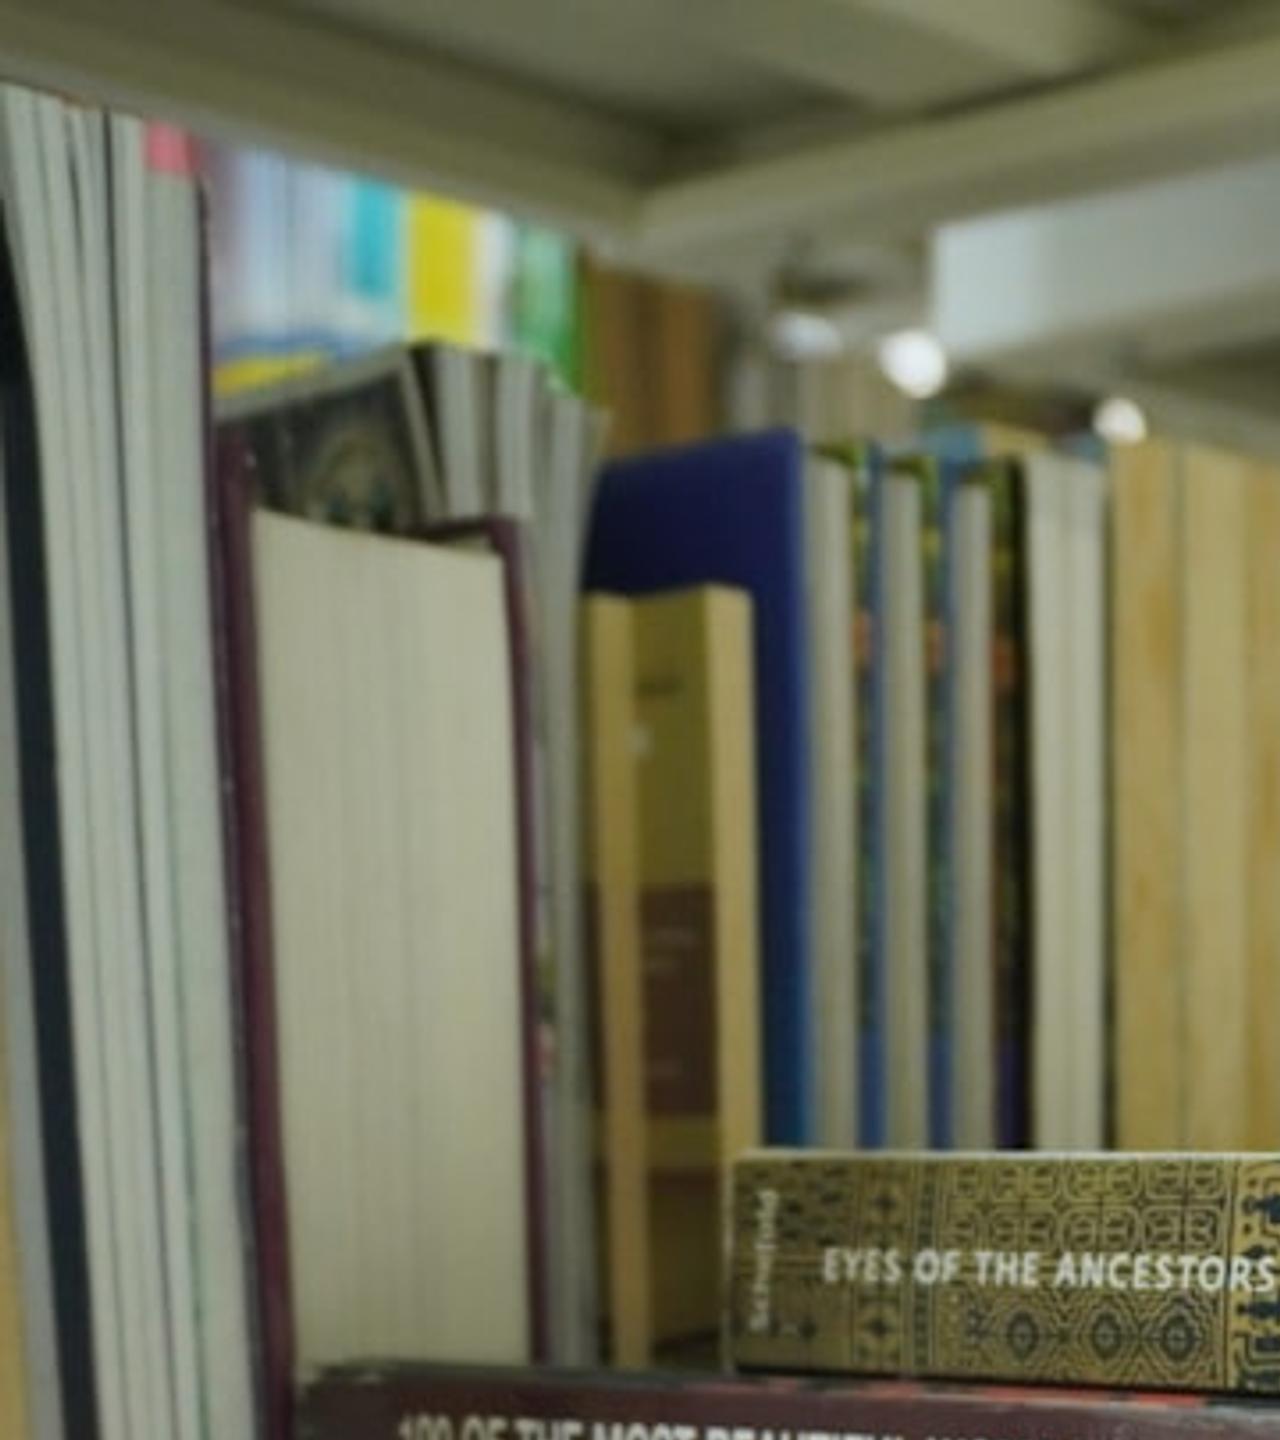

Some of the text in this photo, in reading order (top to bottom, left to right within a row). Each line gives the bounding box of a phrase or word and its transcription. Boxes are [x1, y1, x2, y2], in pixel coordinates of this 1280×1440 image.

[823, 1248, 1277, 1293] EYES OF THE ANCESTORS
